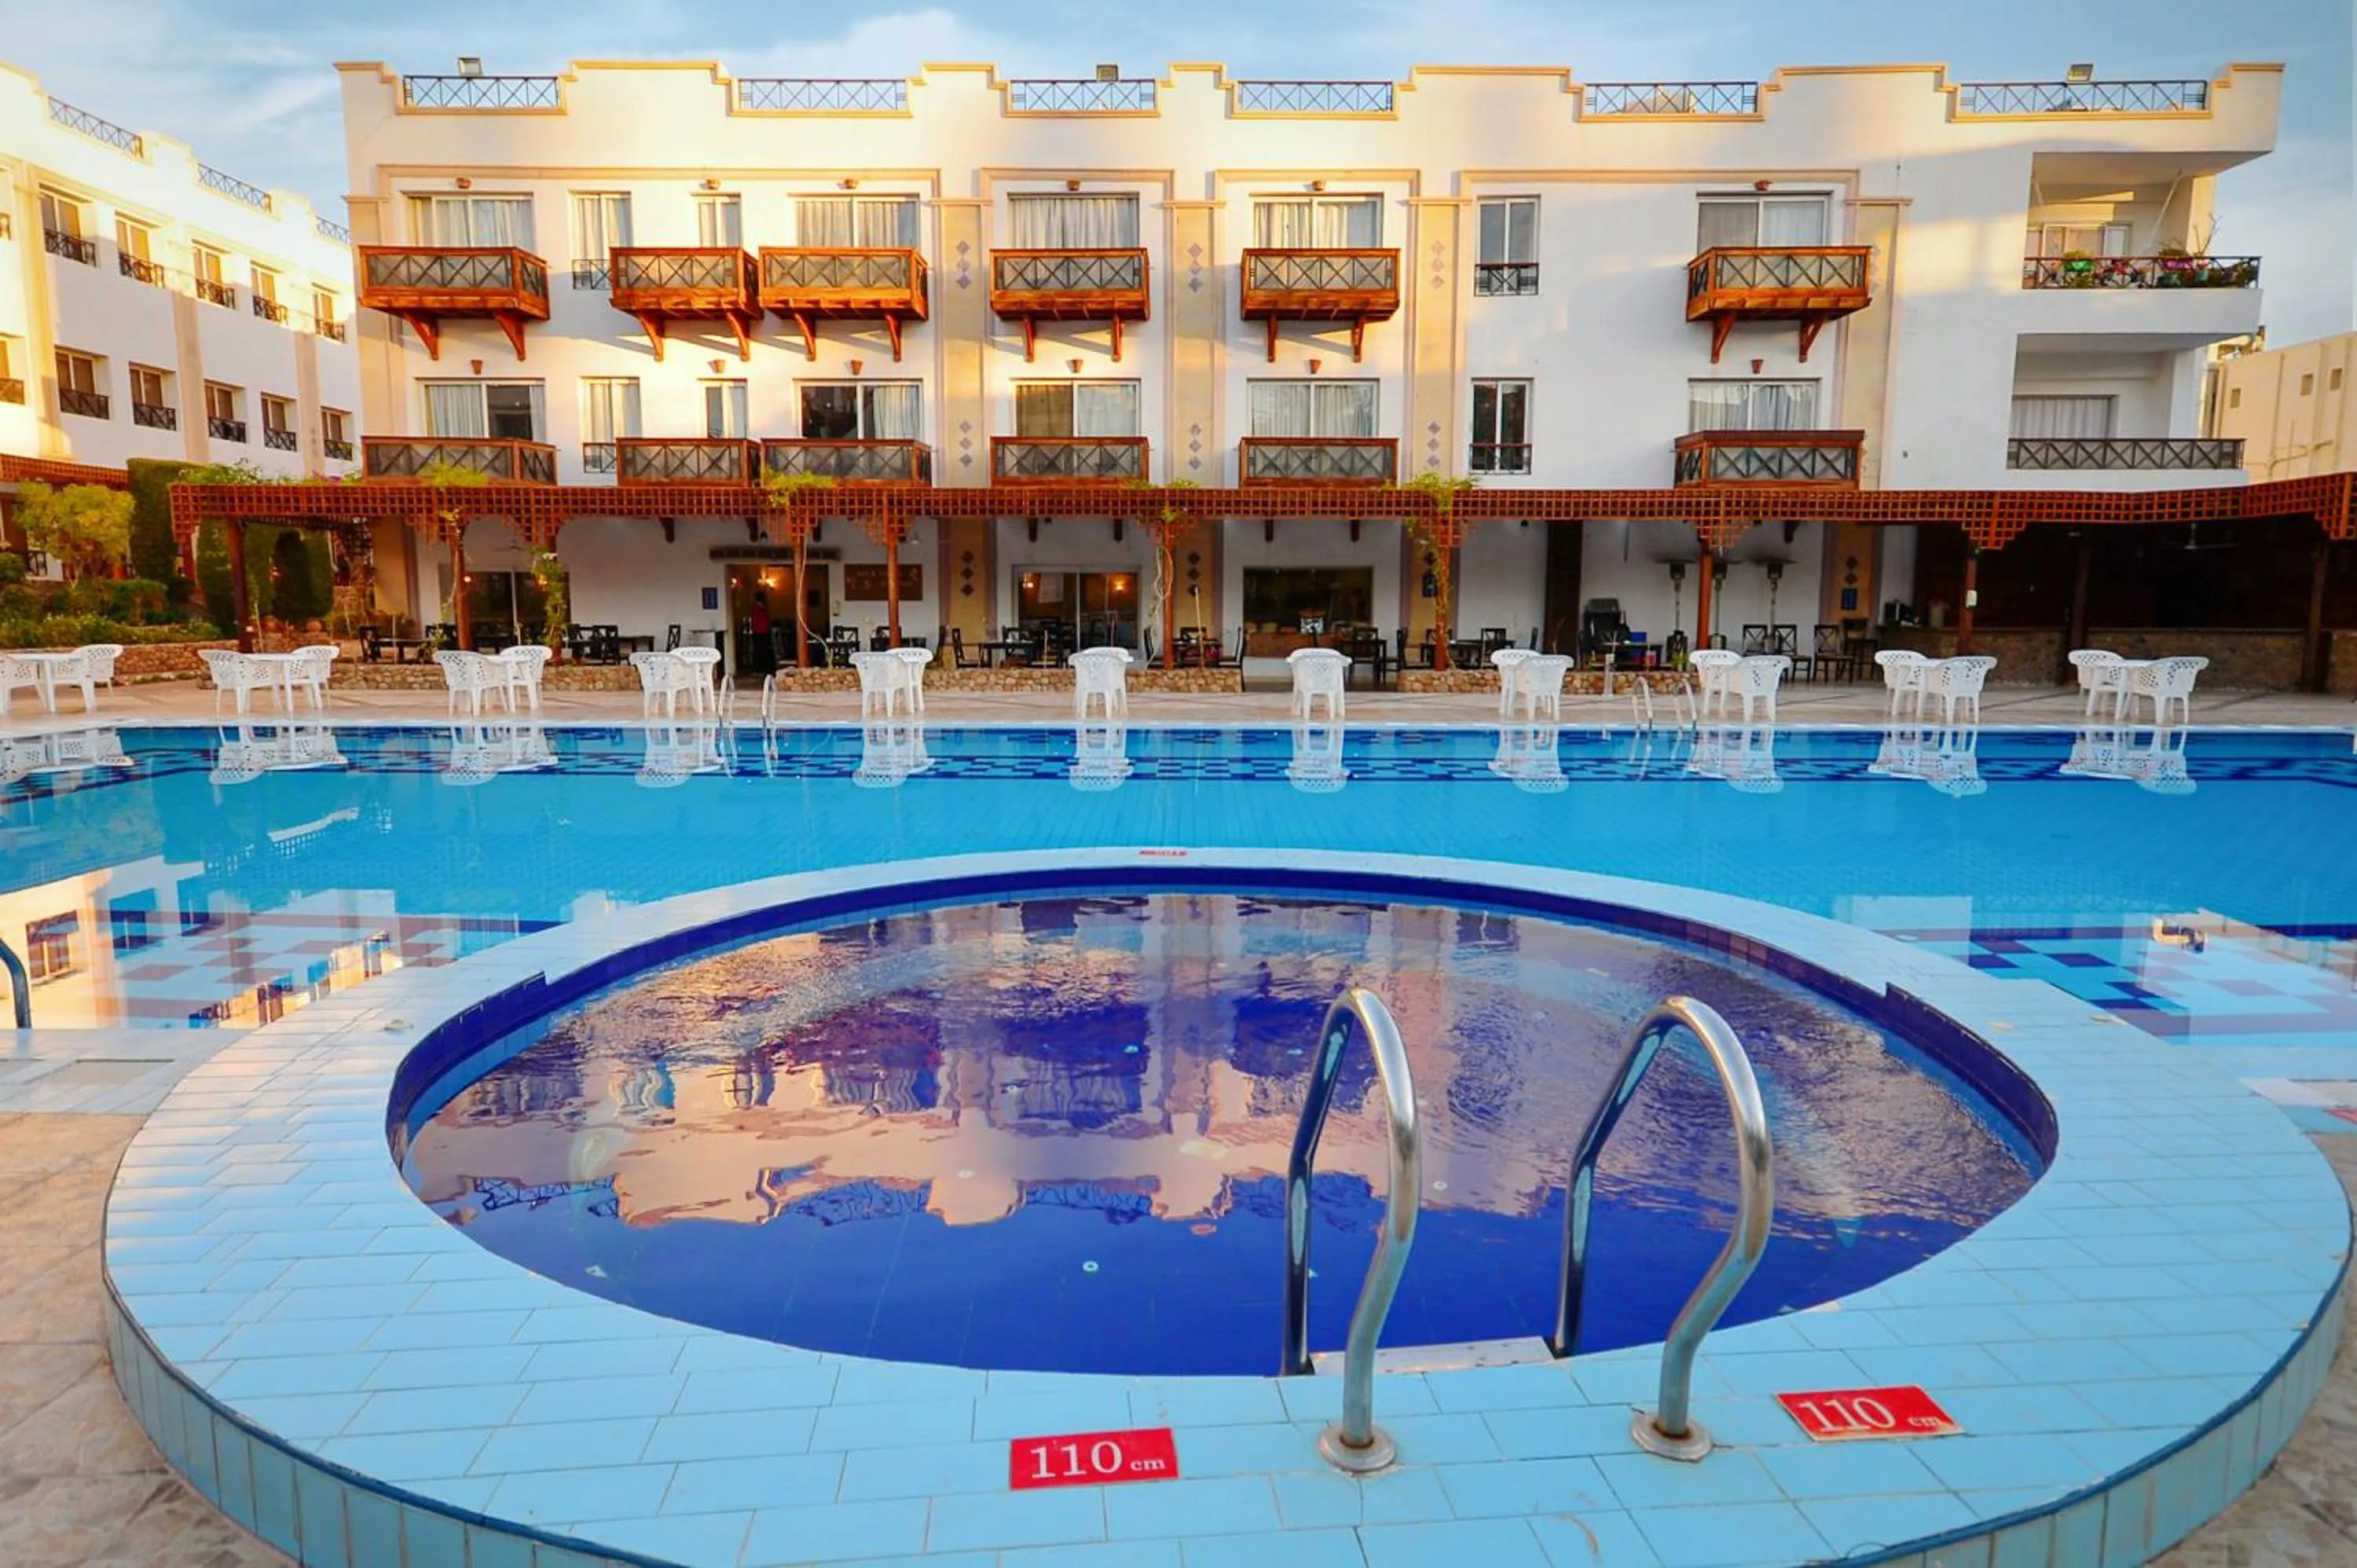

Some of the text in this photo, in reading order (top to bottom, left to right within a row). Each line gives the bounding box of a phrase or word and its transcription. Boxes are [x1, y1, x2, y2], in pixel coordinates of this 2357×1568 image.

[1800, 1398, 1942, 1431] 110 cm
[1031, 1442, 1166, 1478] 110 cm
